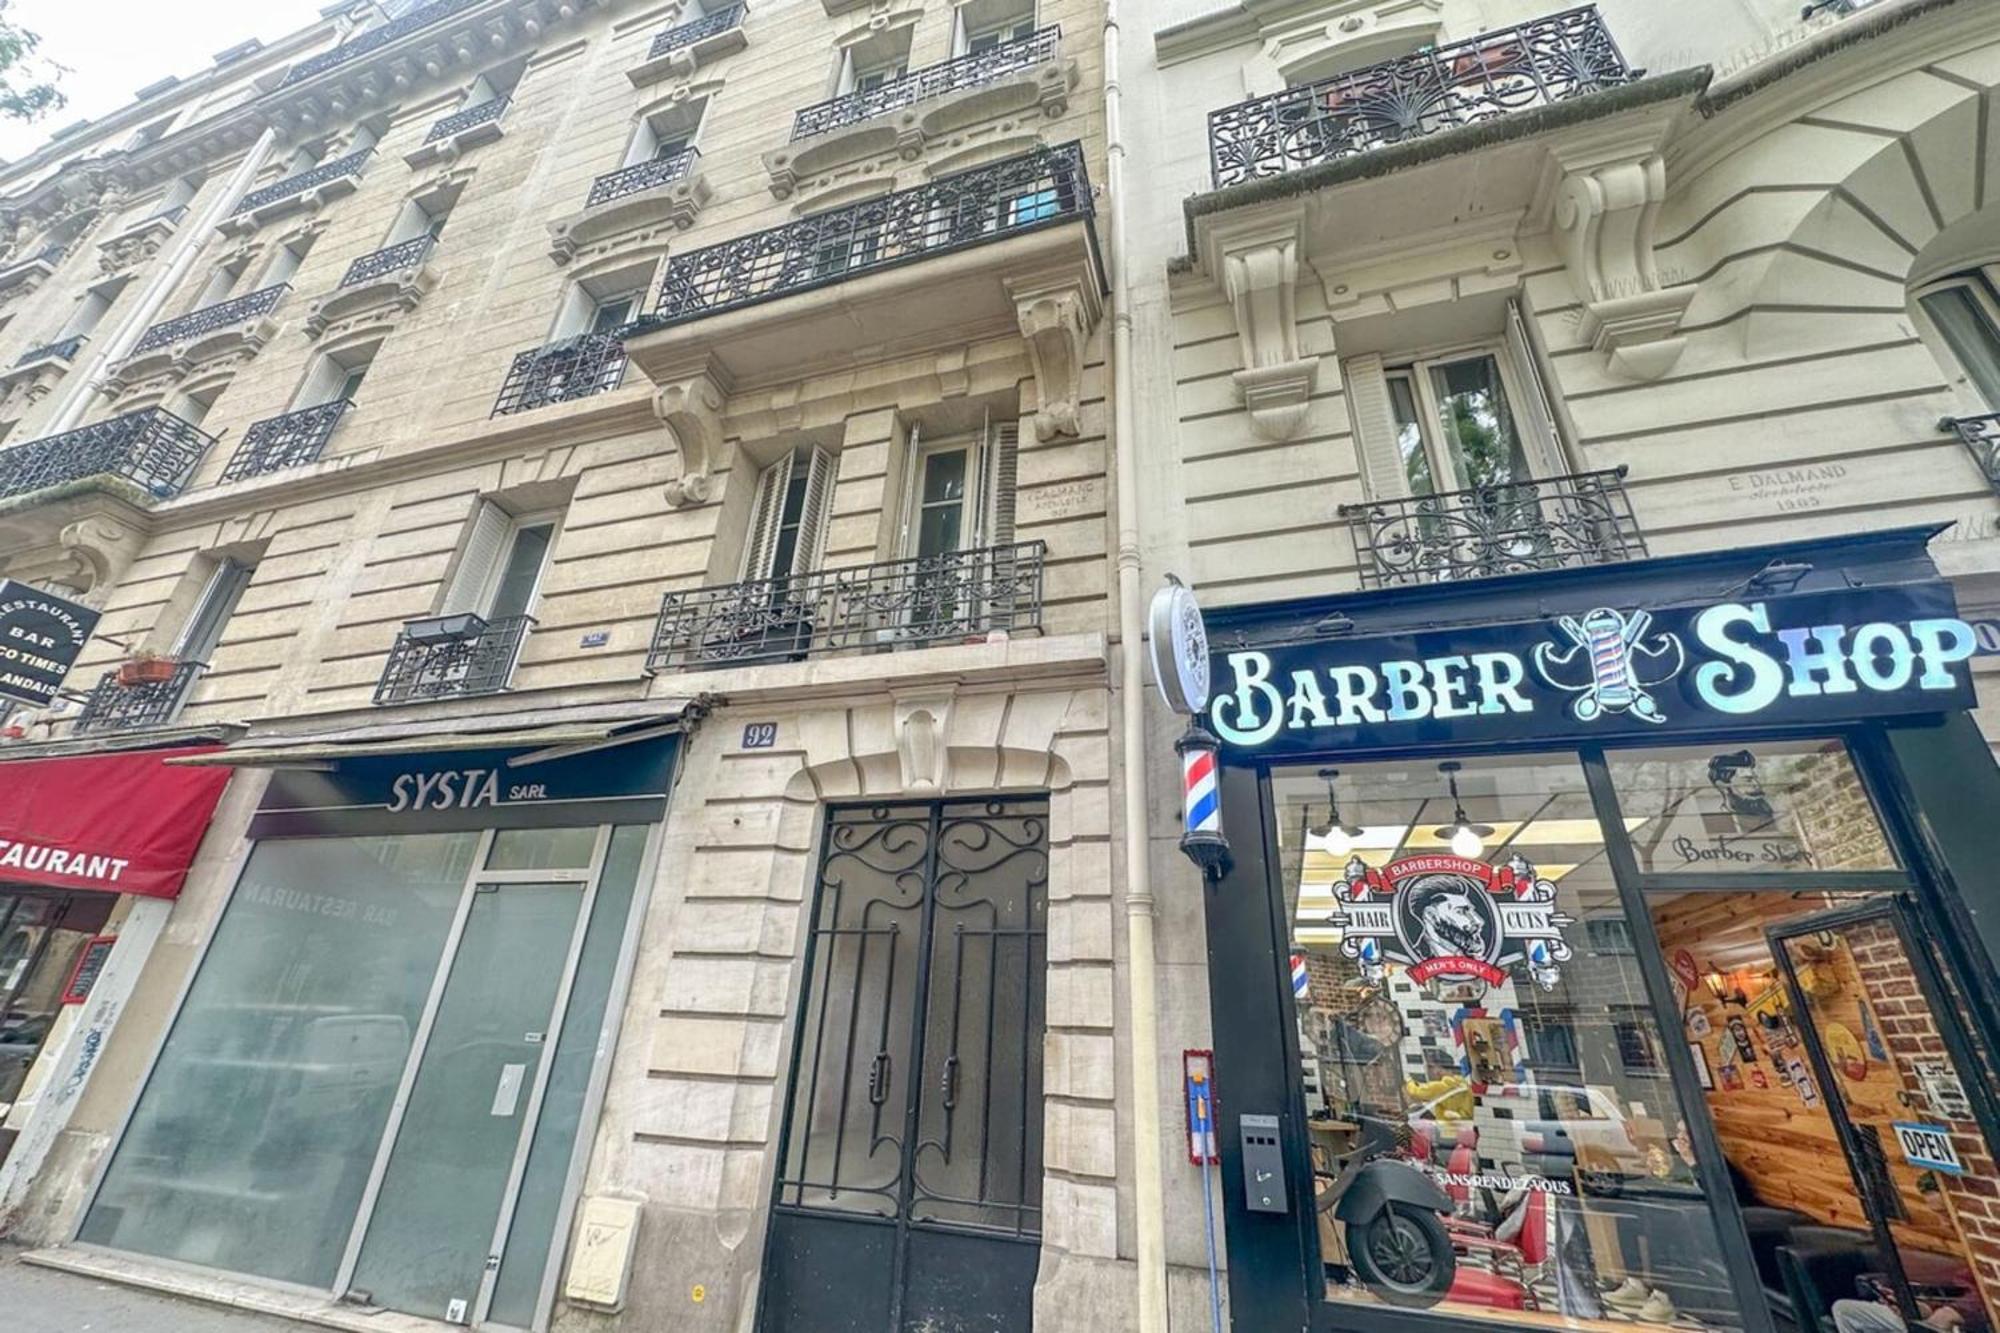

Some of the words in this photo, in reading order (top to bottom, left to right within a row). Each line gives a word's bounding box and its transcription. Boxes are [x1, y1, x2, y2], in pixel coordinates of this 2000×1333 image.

[1749, 465, 1846, 488] DALMAND
[9, 627, 55, 648] BAR
[21, 652, 67, 674] TIMES
[747, 725, 773, 745] 92
[387, 768, 499, 813] SYSTA
[509, 784, 547, 799] SARL
[1673, 836, 1754, 862] Barber
[1391, 858, 1482, 876] BARBERSHOP
[1356, 912, 1389, 928] HAIR
[1506, 911, 1542, 929] CUTS
[1425, 960, 1456, 973] MEN'S
[1458, 960, 1485, 973] ONLY
[1902, 1130, 1953, 1162] OPEN
[1437, 1172, 1471, 1186] SANS
[1473, 1175, 1571, 1194] RENDEZ-VOUS
